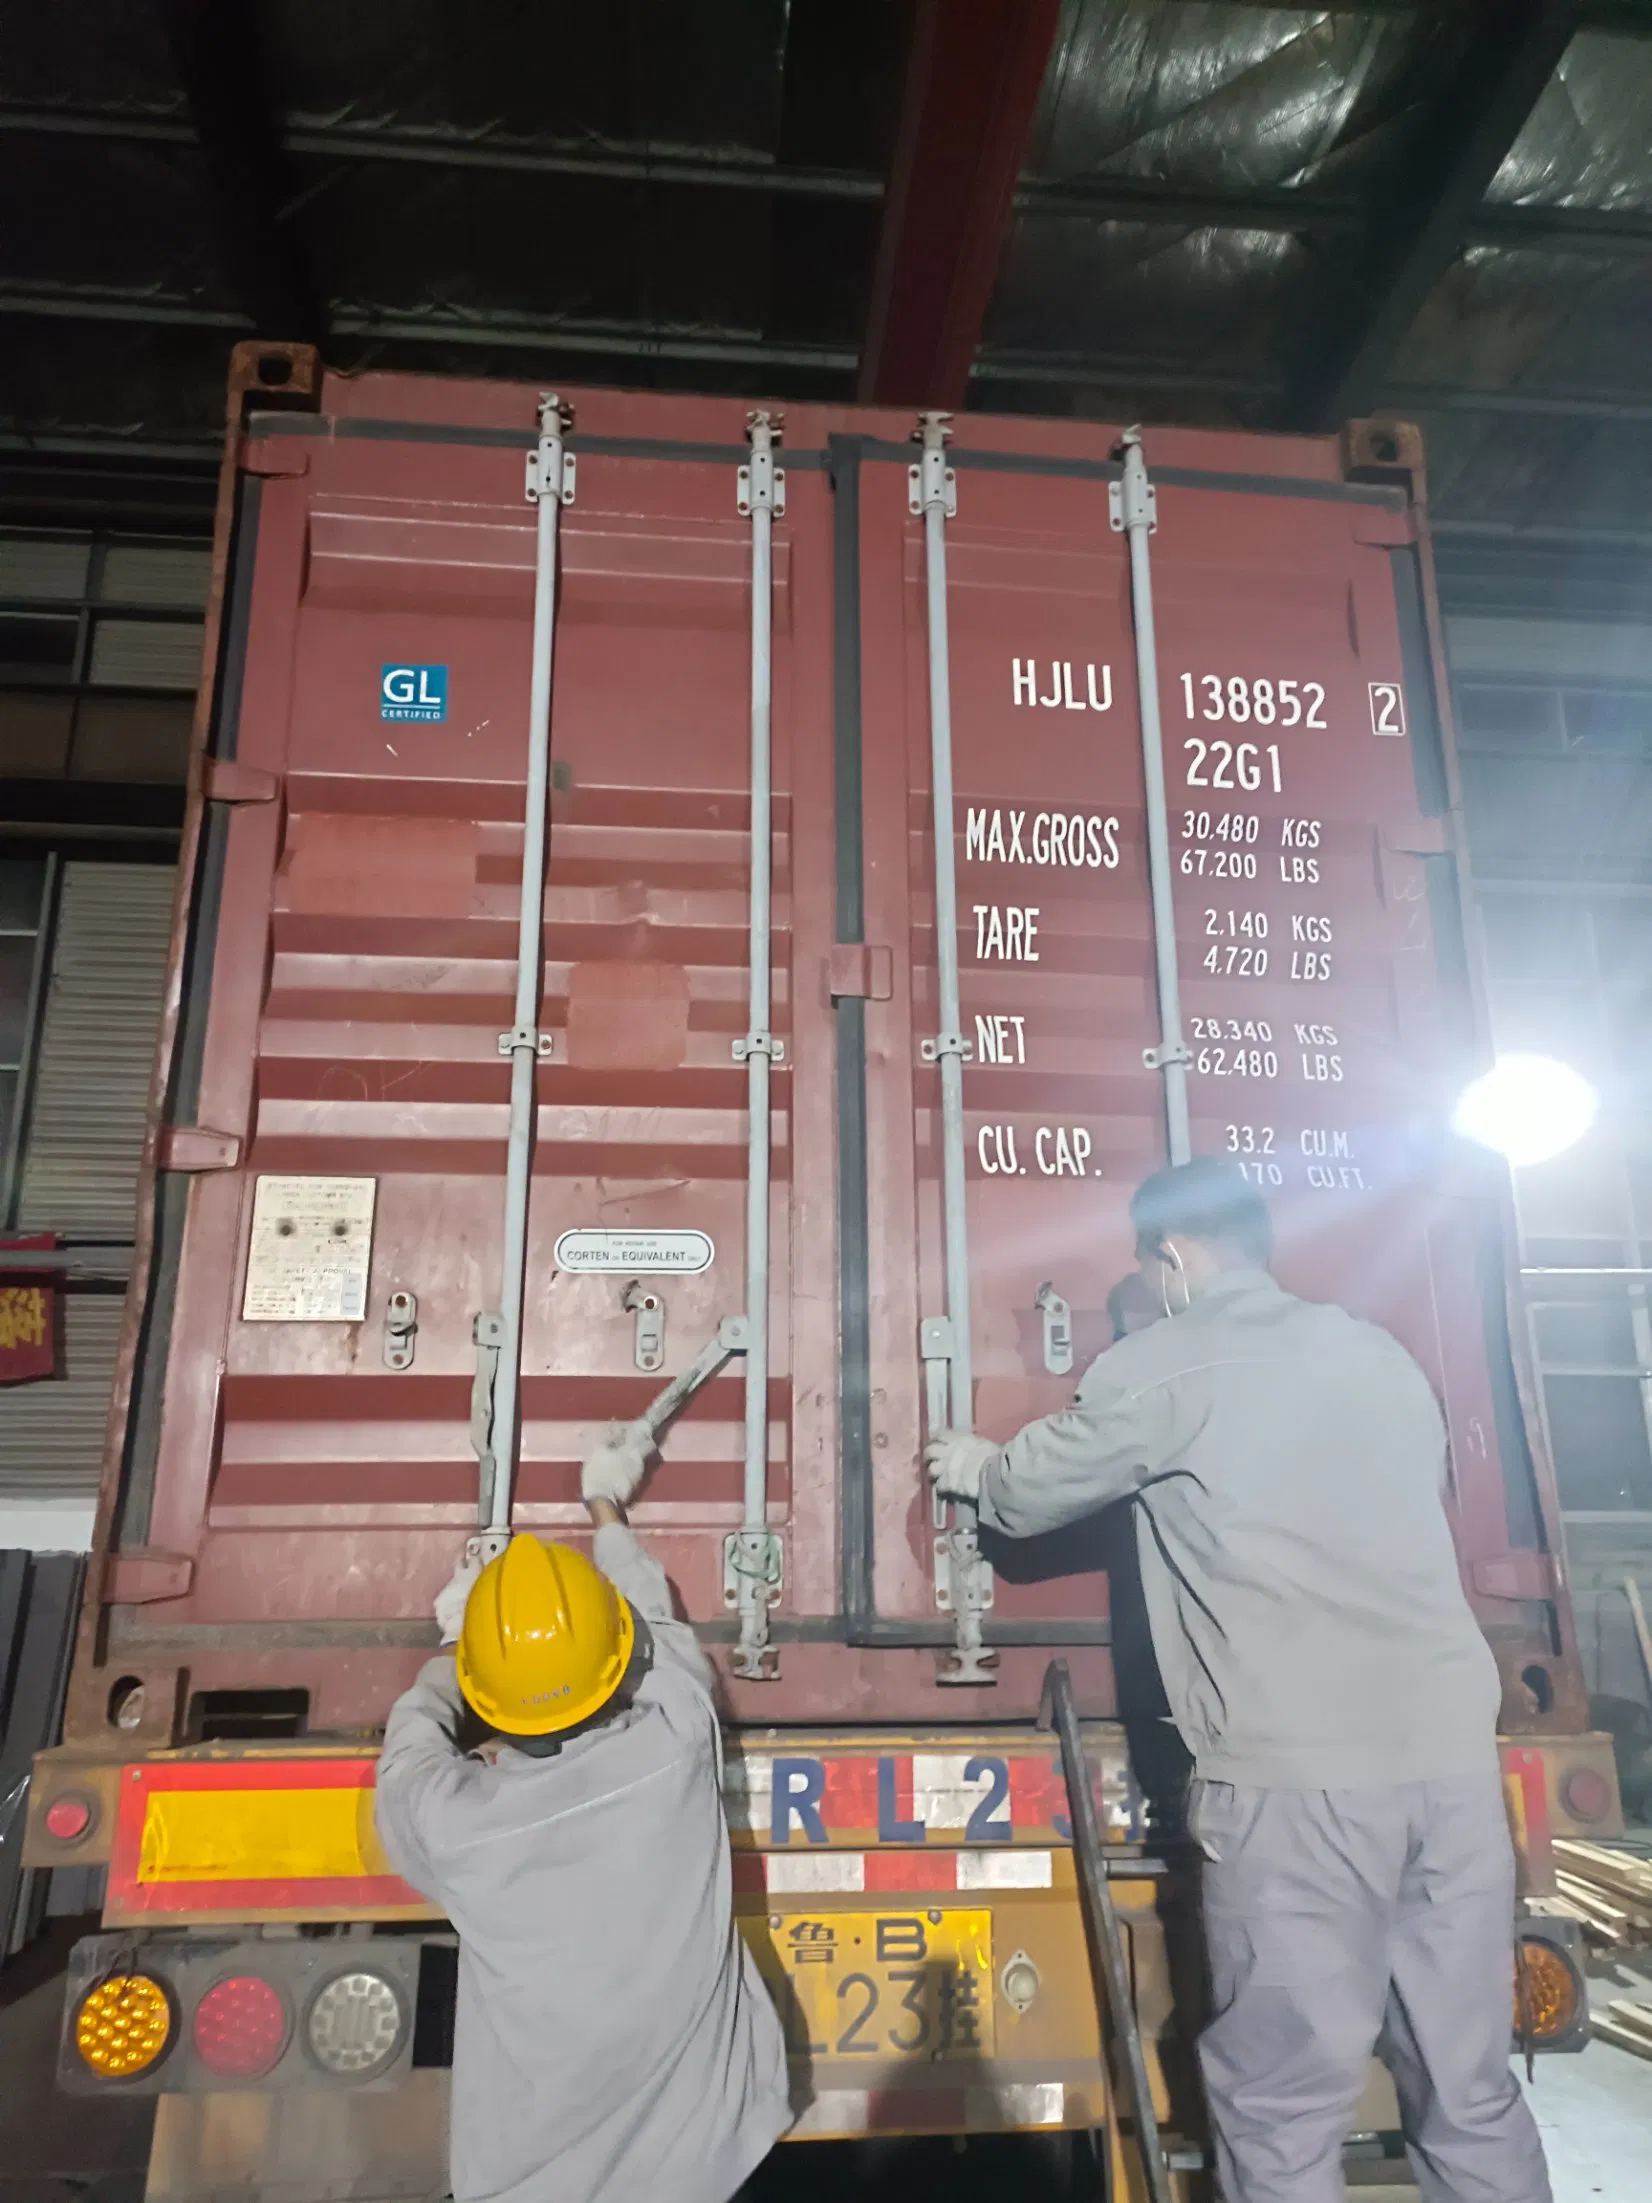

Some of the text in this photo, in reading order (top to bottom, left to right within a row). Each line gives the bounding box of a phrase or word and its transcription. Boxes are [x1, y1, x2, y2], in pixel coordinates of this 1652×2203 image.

[383, 668, 441, 703] GL
[1012, 658, 1400, 732] HJLU 138852 2
[381, 708, 441, 719] CERTIFIED
[1183, 738, 1282, 793] 22G1
[1281, 818, 1321, 849] KGS
[1280, 857, 1320, 883] LBS
[973, 905, 1040, 962] TARE
[1291, 915, 1332, 943] KGS
[1291, 951, 1331, 980] LBS
[974, 1015, 1025, 1064] NET
[1294, 1023, 1338, 1046] KGS
[1302, 1054, 1344, 1082] LBS
[977, 1125, 1027, 1175] CU.
[1035, 1127, 1102, 1177] CAP.
[1226, 1124, 1276, 1155] 33.2
[1237, 1162, 1283, 1186] 170
[566, 1250, 610, 1262] CORTEN
[621, 1250, 686, 1262] EQUIVALENT
